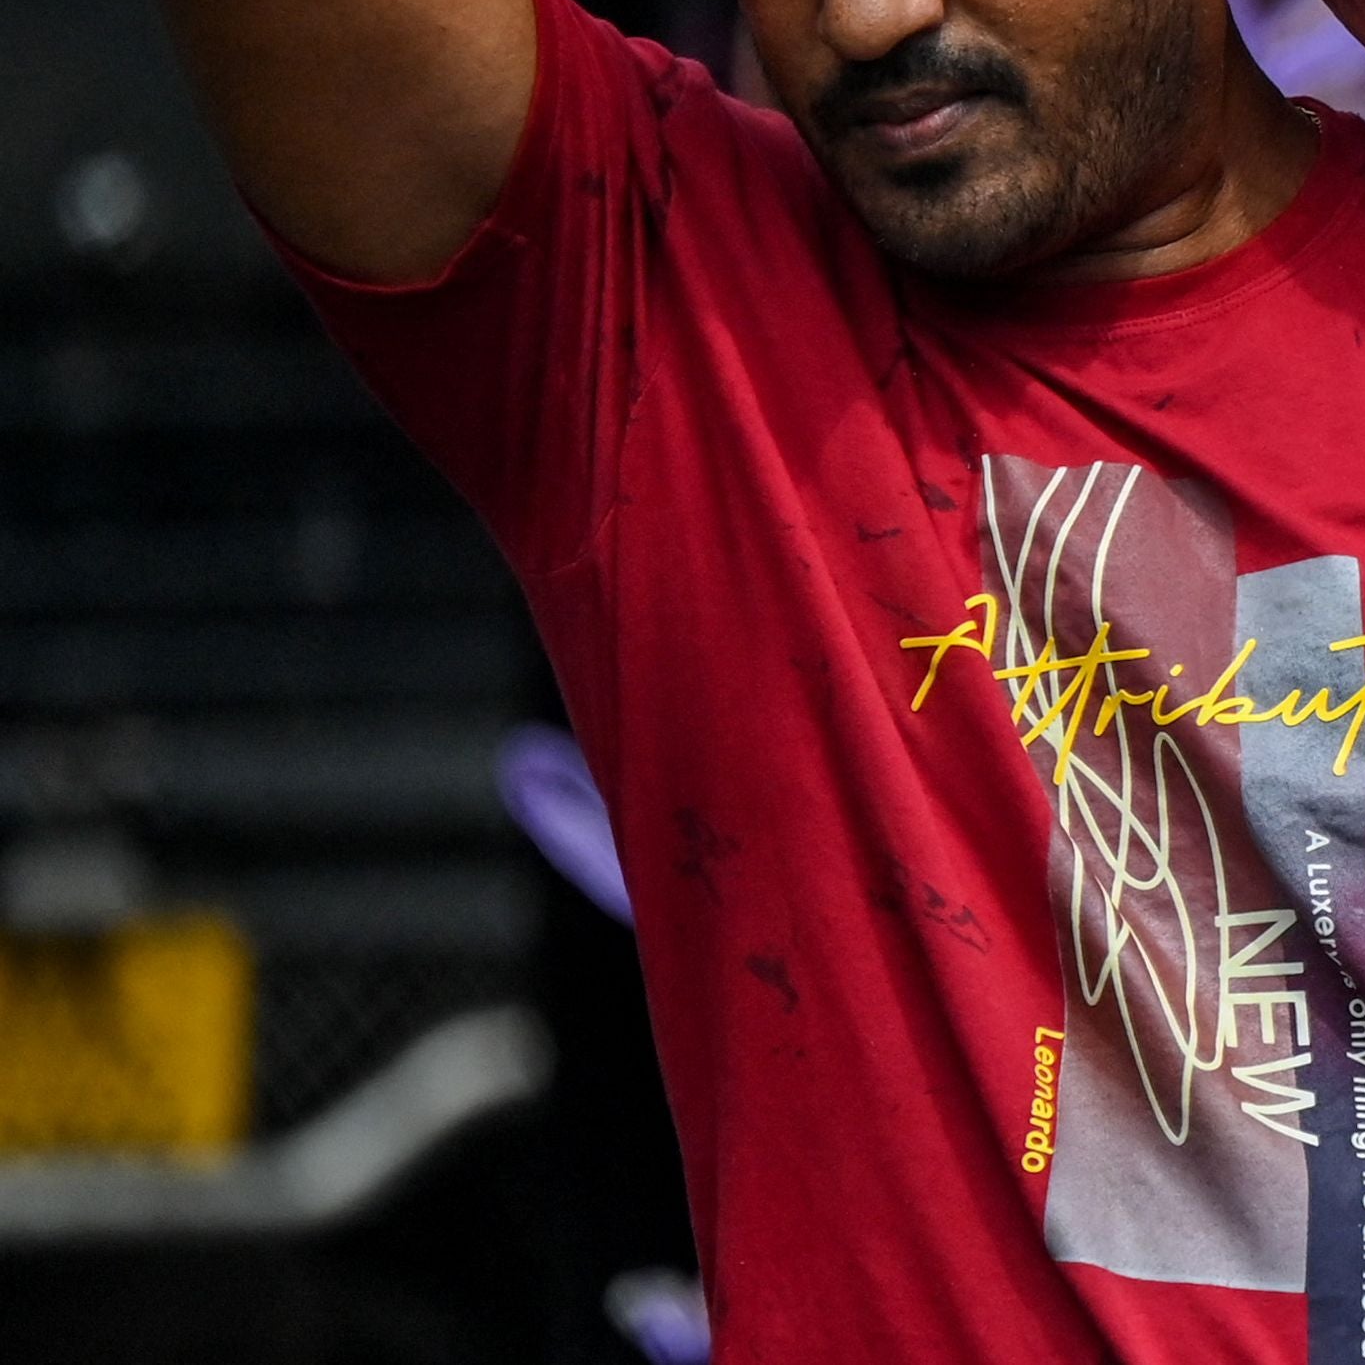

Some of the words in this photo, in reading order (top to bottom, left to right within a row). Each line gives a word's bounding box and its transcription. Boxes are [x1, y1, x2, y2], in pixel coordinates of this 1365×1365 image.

[1305, 829, 1330, 852] A
[1021, 1026, 1065, 1173] Leonardo
[1214, 909, 1319, 1146] NEW
